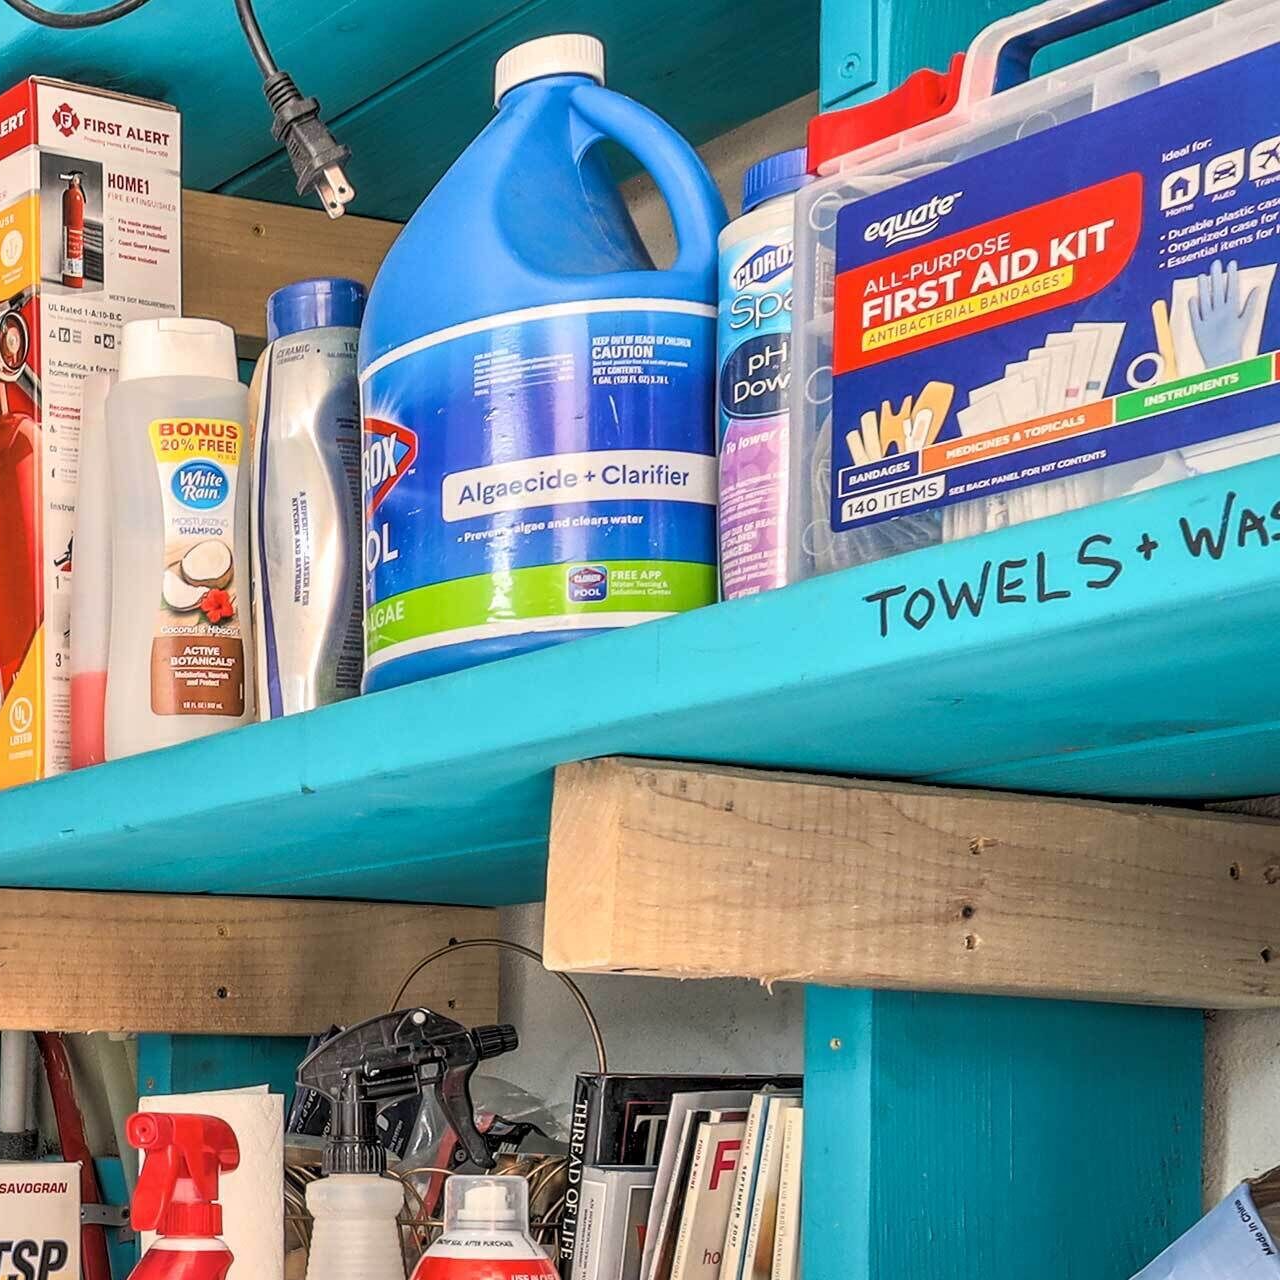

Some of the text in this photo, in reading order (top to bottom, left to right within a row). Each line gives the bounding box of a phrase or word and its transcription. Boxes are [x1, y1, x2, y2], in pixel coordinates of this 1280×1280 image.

[84, 118, 170, 146] FIRST ALERT
[1161, 138, 1213, 164] Ideal for:
[108, 173, 150, 195] HOME1
[1212, 190, 1237, 203] Auto
[863, 194, 955, 248] equate
[1165, 203, 1195, 218] Home
[1168, 219, 1214, 241] Durable
[1216, 205, 1255, 227] plastic
[1168, 211, 1280, 254] Organized case for
[1167, 226, 1275, 269] Essential items for
[862, 219, 1115, 328] FIRST AID KIT
[864, 232, 1011, 297] ALL-PURPOSE
[60, 305, 82, 315] Rated
[868, 303, 975, 346] ANTIBACTERIAL
[592, 346, 653, 359] CAUTION
[748, 342, 788, 376] pH
[1143, 372, 1240, 408] INSTRUMENTS
[159, 423, 238, 439] BONUS
[945, 433, 1011, 460] MEDICINES
[1024, 414, 1085, 438] TOPICALS
[160, 439, 237, 454] 20% FREE!
[180, 470, 223, 489] White
[458, 464, 690, 505] Algaecide + Clarifier
[848, 460, 911, 487] BANDAGES
[948, 486, 965, 497] SEE
[966, 479, 990, 493] BACK
[991, 473, 1019, 488] PANEL
[1021, 467, 1040, 480] FOR
[1057, 449, 1107, 470] CONTENTS
[847, 482, 939, 518] 140 ITEMS
[171, 517, 229, 527] MOISTURIZING
[179, 526, 223, 536] SHAMPOO
[514, 521, 545, 535] algae
[547, 517, 570, 529] and
[572, 516, 608, 527] clears
[610, 515, 643, 525] water
[611, 571, 662, 580] FREE APP
[862, 534, 1123, 638] TOWELS
[574, 588, 601, 597] POOL
[183, 646, 220, 655] ACTIVE
[560, 1100, 588, 1262] THREAD OF LIFE
[736, 1165, 747, 1218] SEPTEMBER
